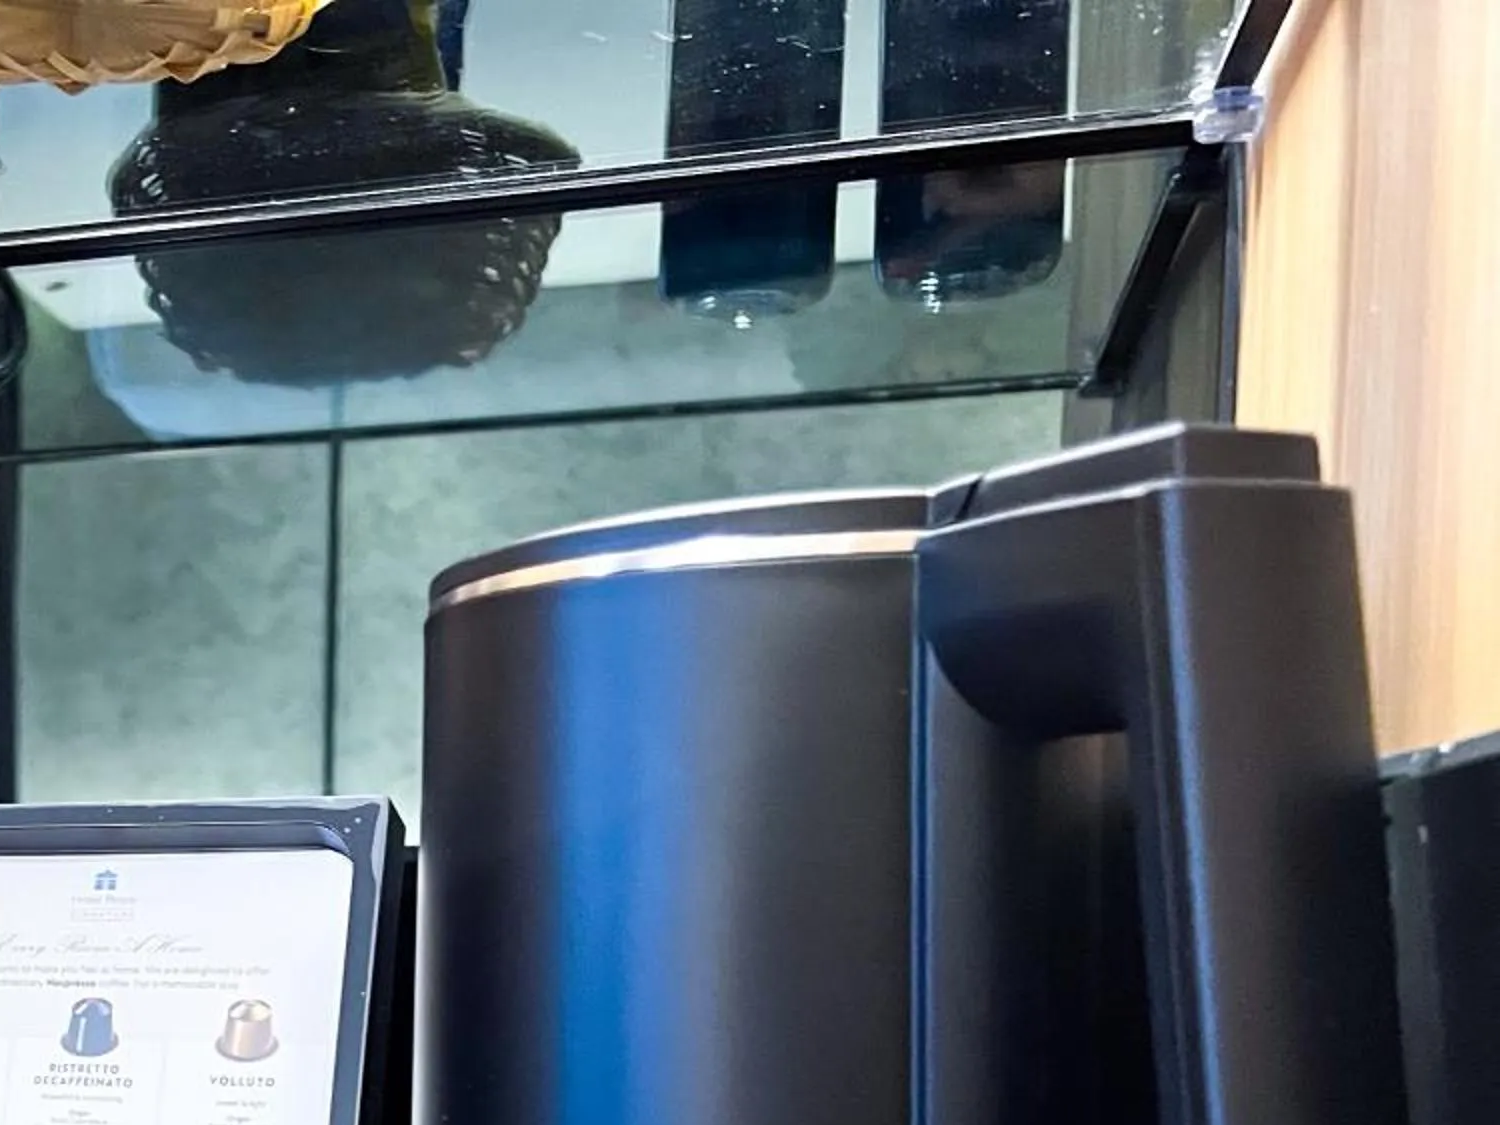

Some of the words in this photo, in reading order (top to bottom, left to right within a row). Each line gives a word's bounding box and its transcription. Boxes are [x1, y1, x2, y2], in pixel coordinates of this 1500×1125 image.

[49, 1063, 120, 1075] RISTRETTO
[33, 1075, 134, 1089] DECAFFEINATO
[209, 1075, 276, 1087] VOLLUTO
